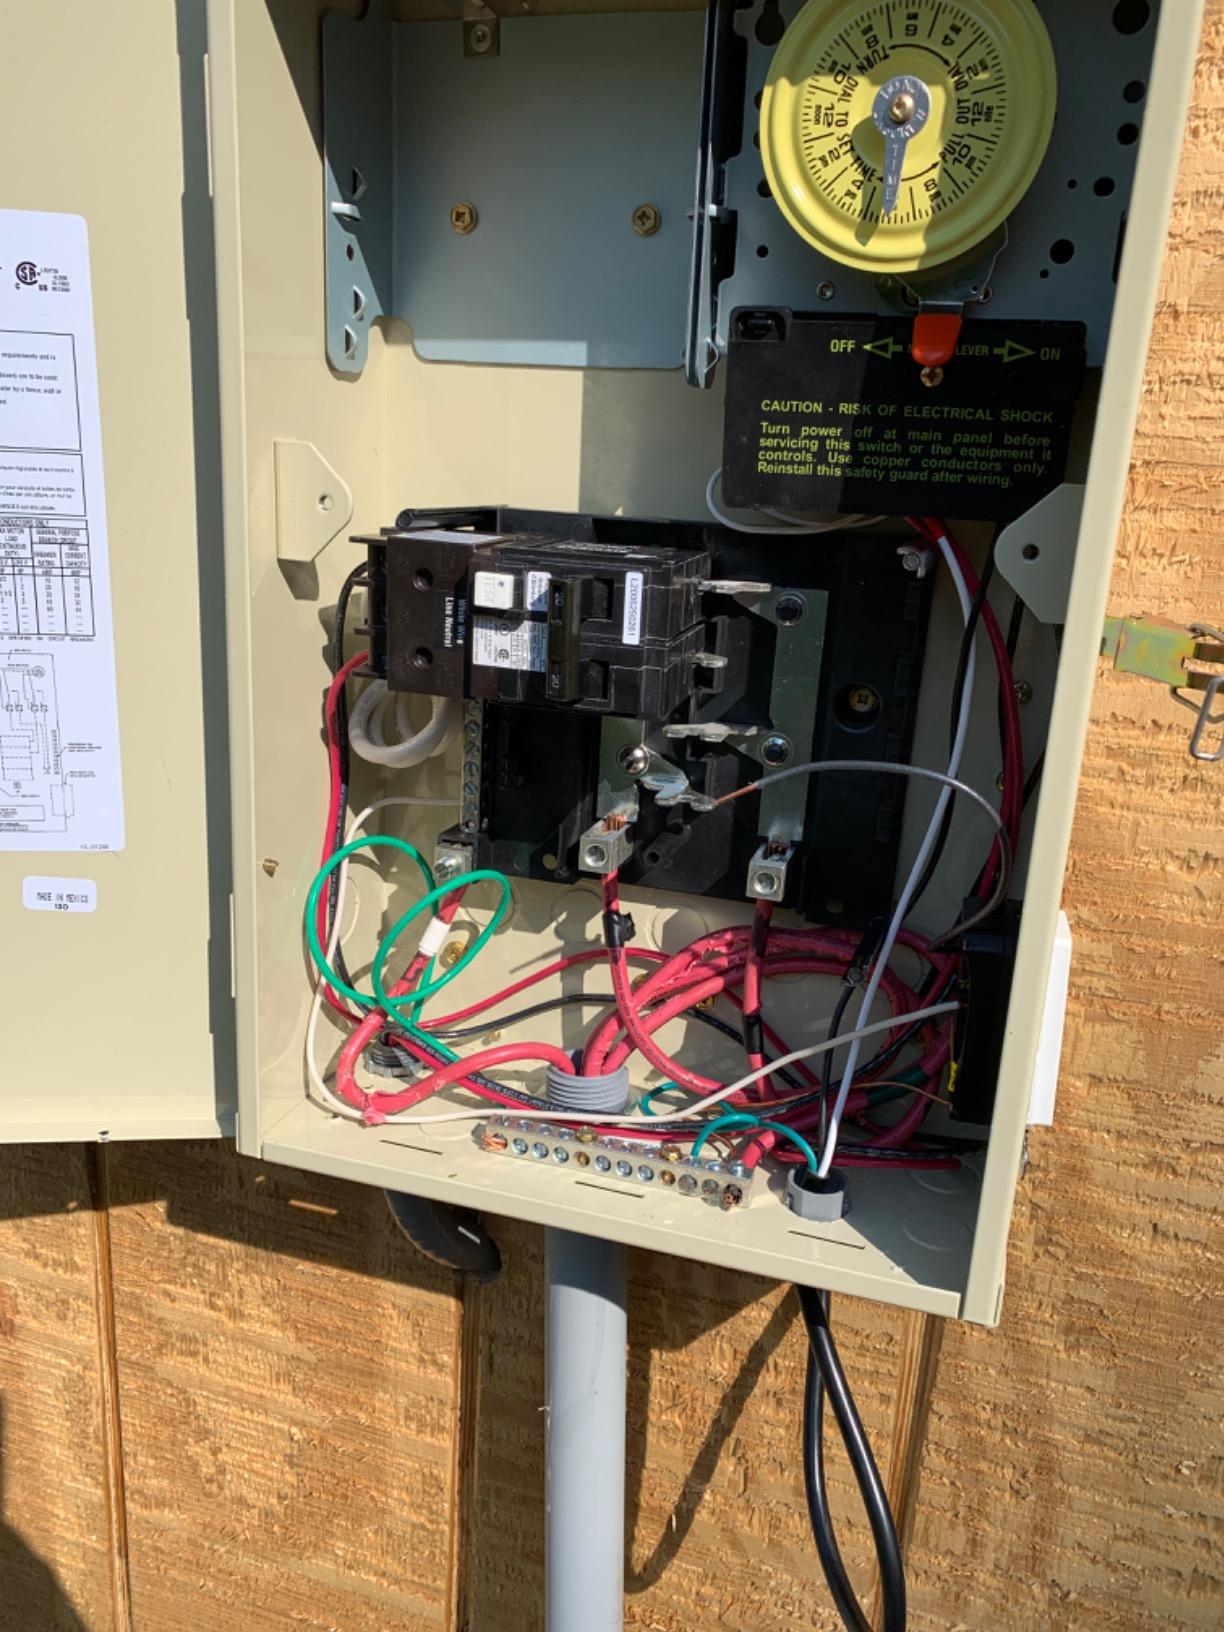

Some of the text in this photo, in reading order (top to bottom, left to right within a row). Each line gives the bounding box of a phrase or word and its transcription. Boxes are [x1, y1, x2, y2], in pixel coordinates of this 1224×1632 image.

[905, 24, 918, 36] 6
[942, 33, 955, 46] 4
[865, 34, 879, 49] 8
[834, 63, 852, 85] 10
[966, 63, 980, 80] 2
[823, 102, 835, 128] 12
[834, 45, 890, 182] TURN DIAL TO SET TIME
[939, 60, 971, 163] PULL OUT DIAL
[970, 102, 984, 127] 12
[828, 147, 840, 163] 2
[952, 143, 971, 166] 10
[851, 179, 864, 190] 4
[924, 178, 937, 192] 8
[830, 339, 856, 353] OFF
[955, 345, 989, 356] LEVER
[1040, 348, 1061, 361] ON
[761, 400, 823, 413] CAUTION
[839, 402, 872, 416] RISK
[878, 404, 897, 417] OF
[904, 405, 995, 421] ELECTRICAL
[1001, 409, 1054, 423] SHOCK
[760, 422, 1051, 447] Turn power off at main panel before
[759, 436, 819, 452] servicing
[826, 438, 851, 450] this
[858, 440, 902, 453] switch
[909, 444, 924, 454] or
[931, 443, 952, 456] the
[960, 445, 1034, 460] equipment
[758, 450, 1048, 477] controls. Use copper conductors only.
[758, 461, 1014, 488] Reinstall this safety guard after wiring.
[443, 597, 454, 647] Line Neutral
